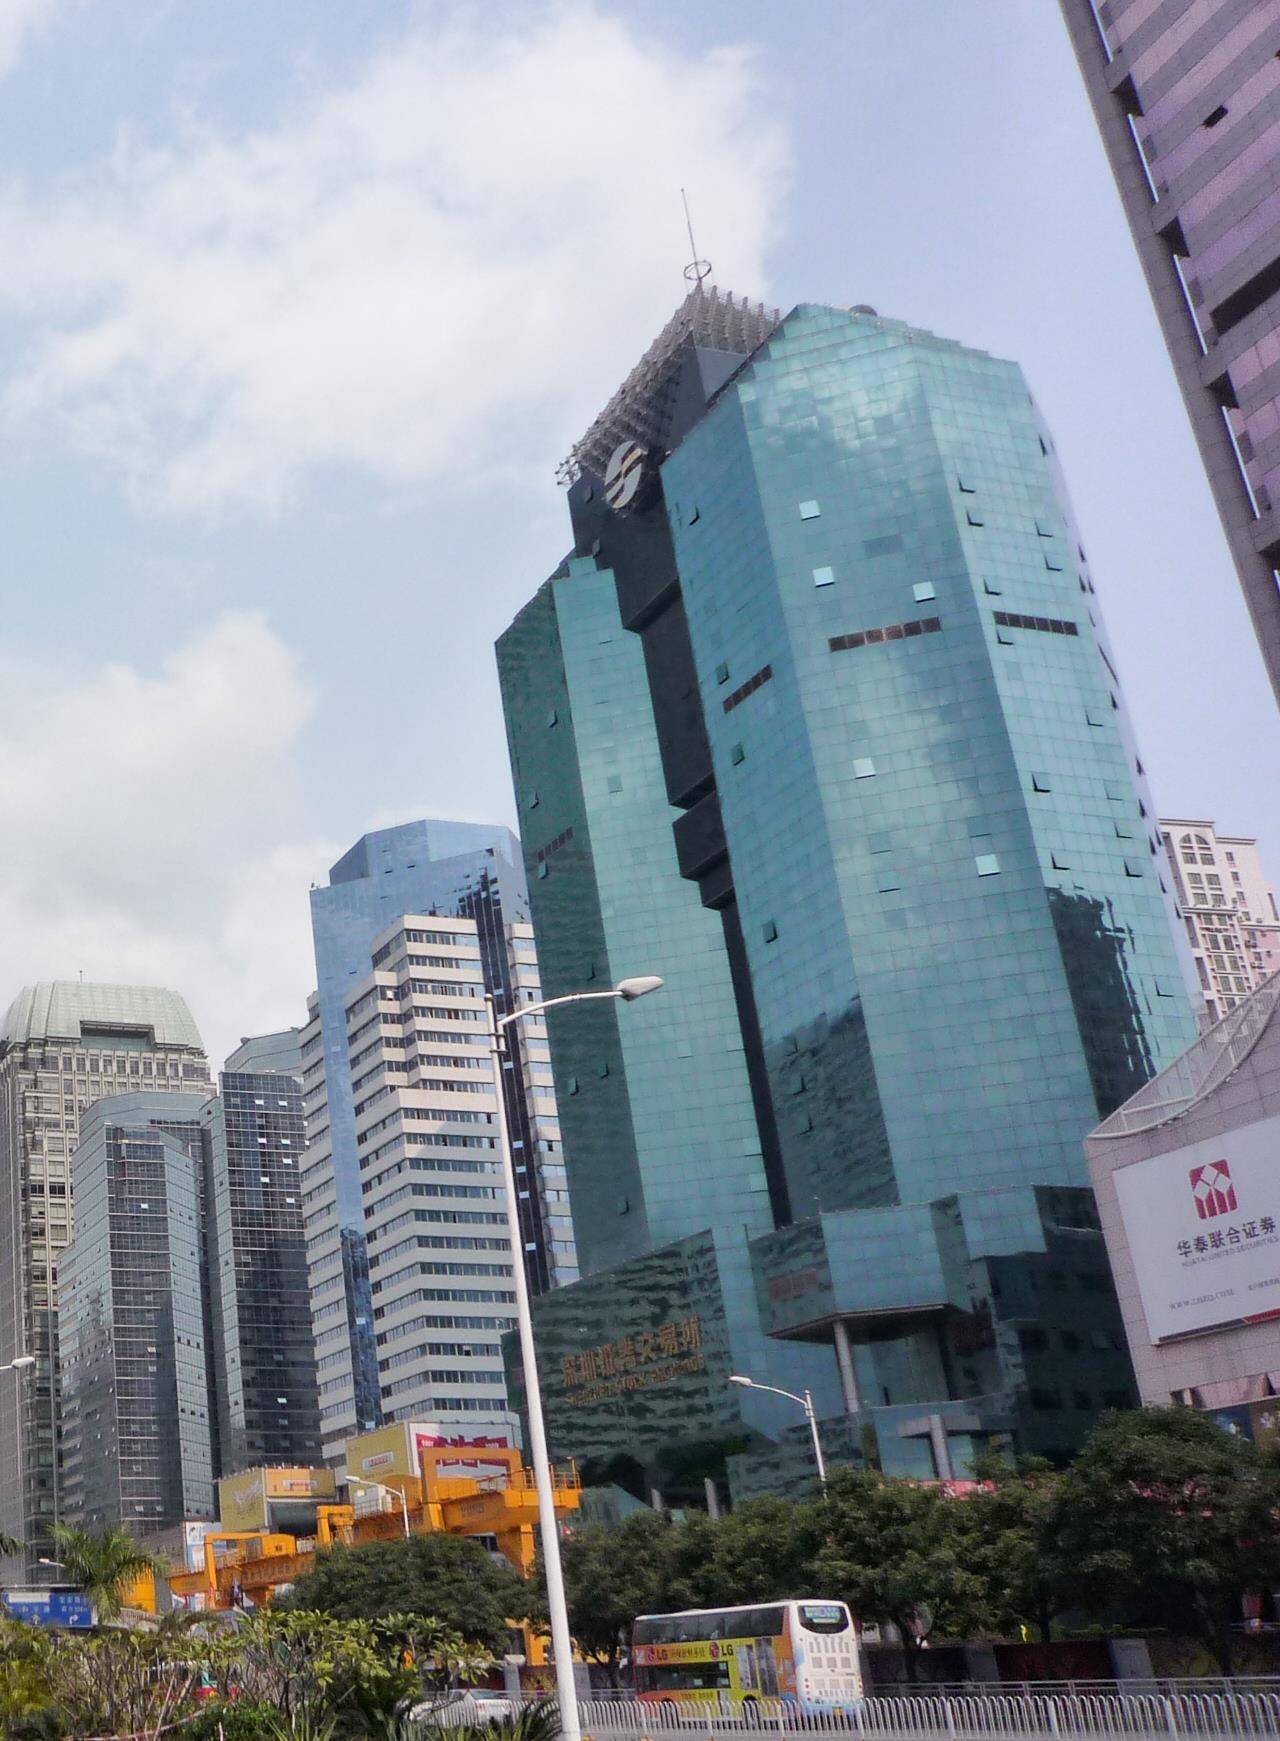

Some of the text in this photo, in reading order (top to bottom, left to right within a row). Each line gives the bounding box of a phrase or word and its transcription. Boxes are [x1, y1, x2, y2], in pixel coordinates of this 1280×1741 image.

[1176, 1216, 1276, 1257] 华泰联合证券
[657, 1649, 668, 1661] LG
[721, 1644, 733, 1656] LG
